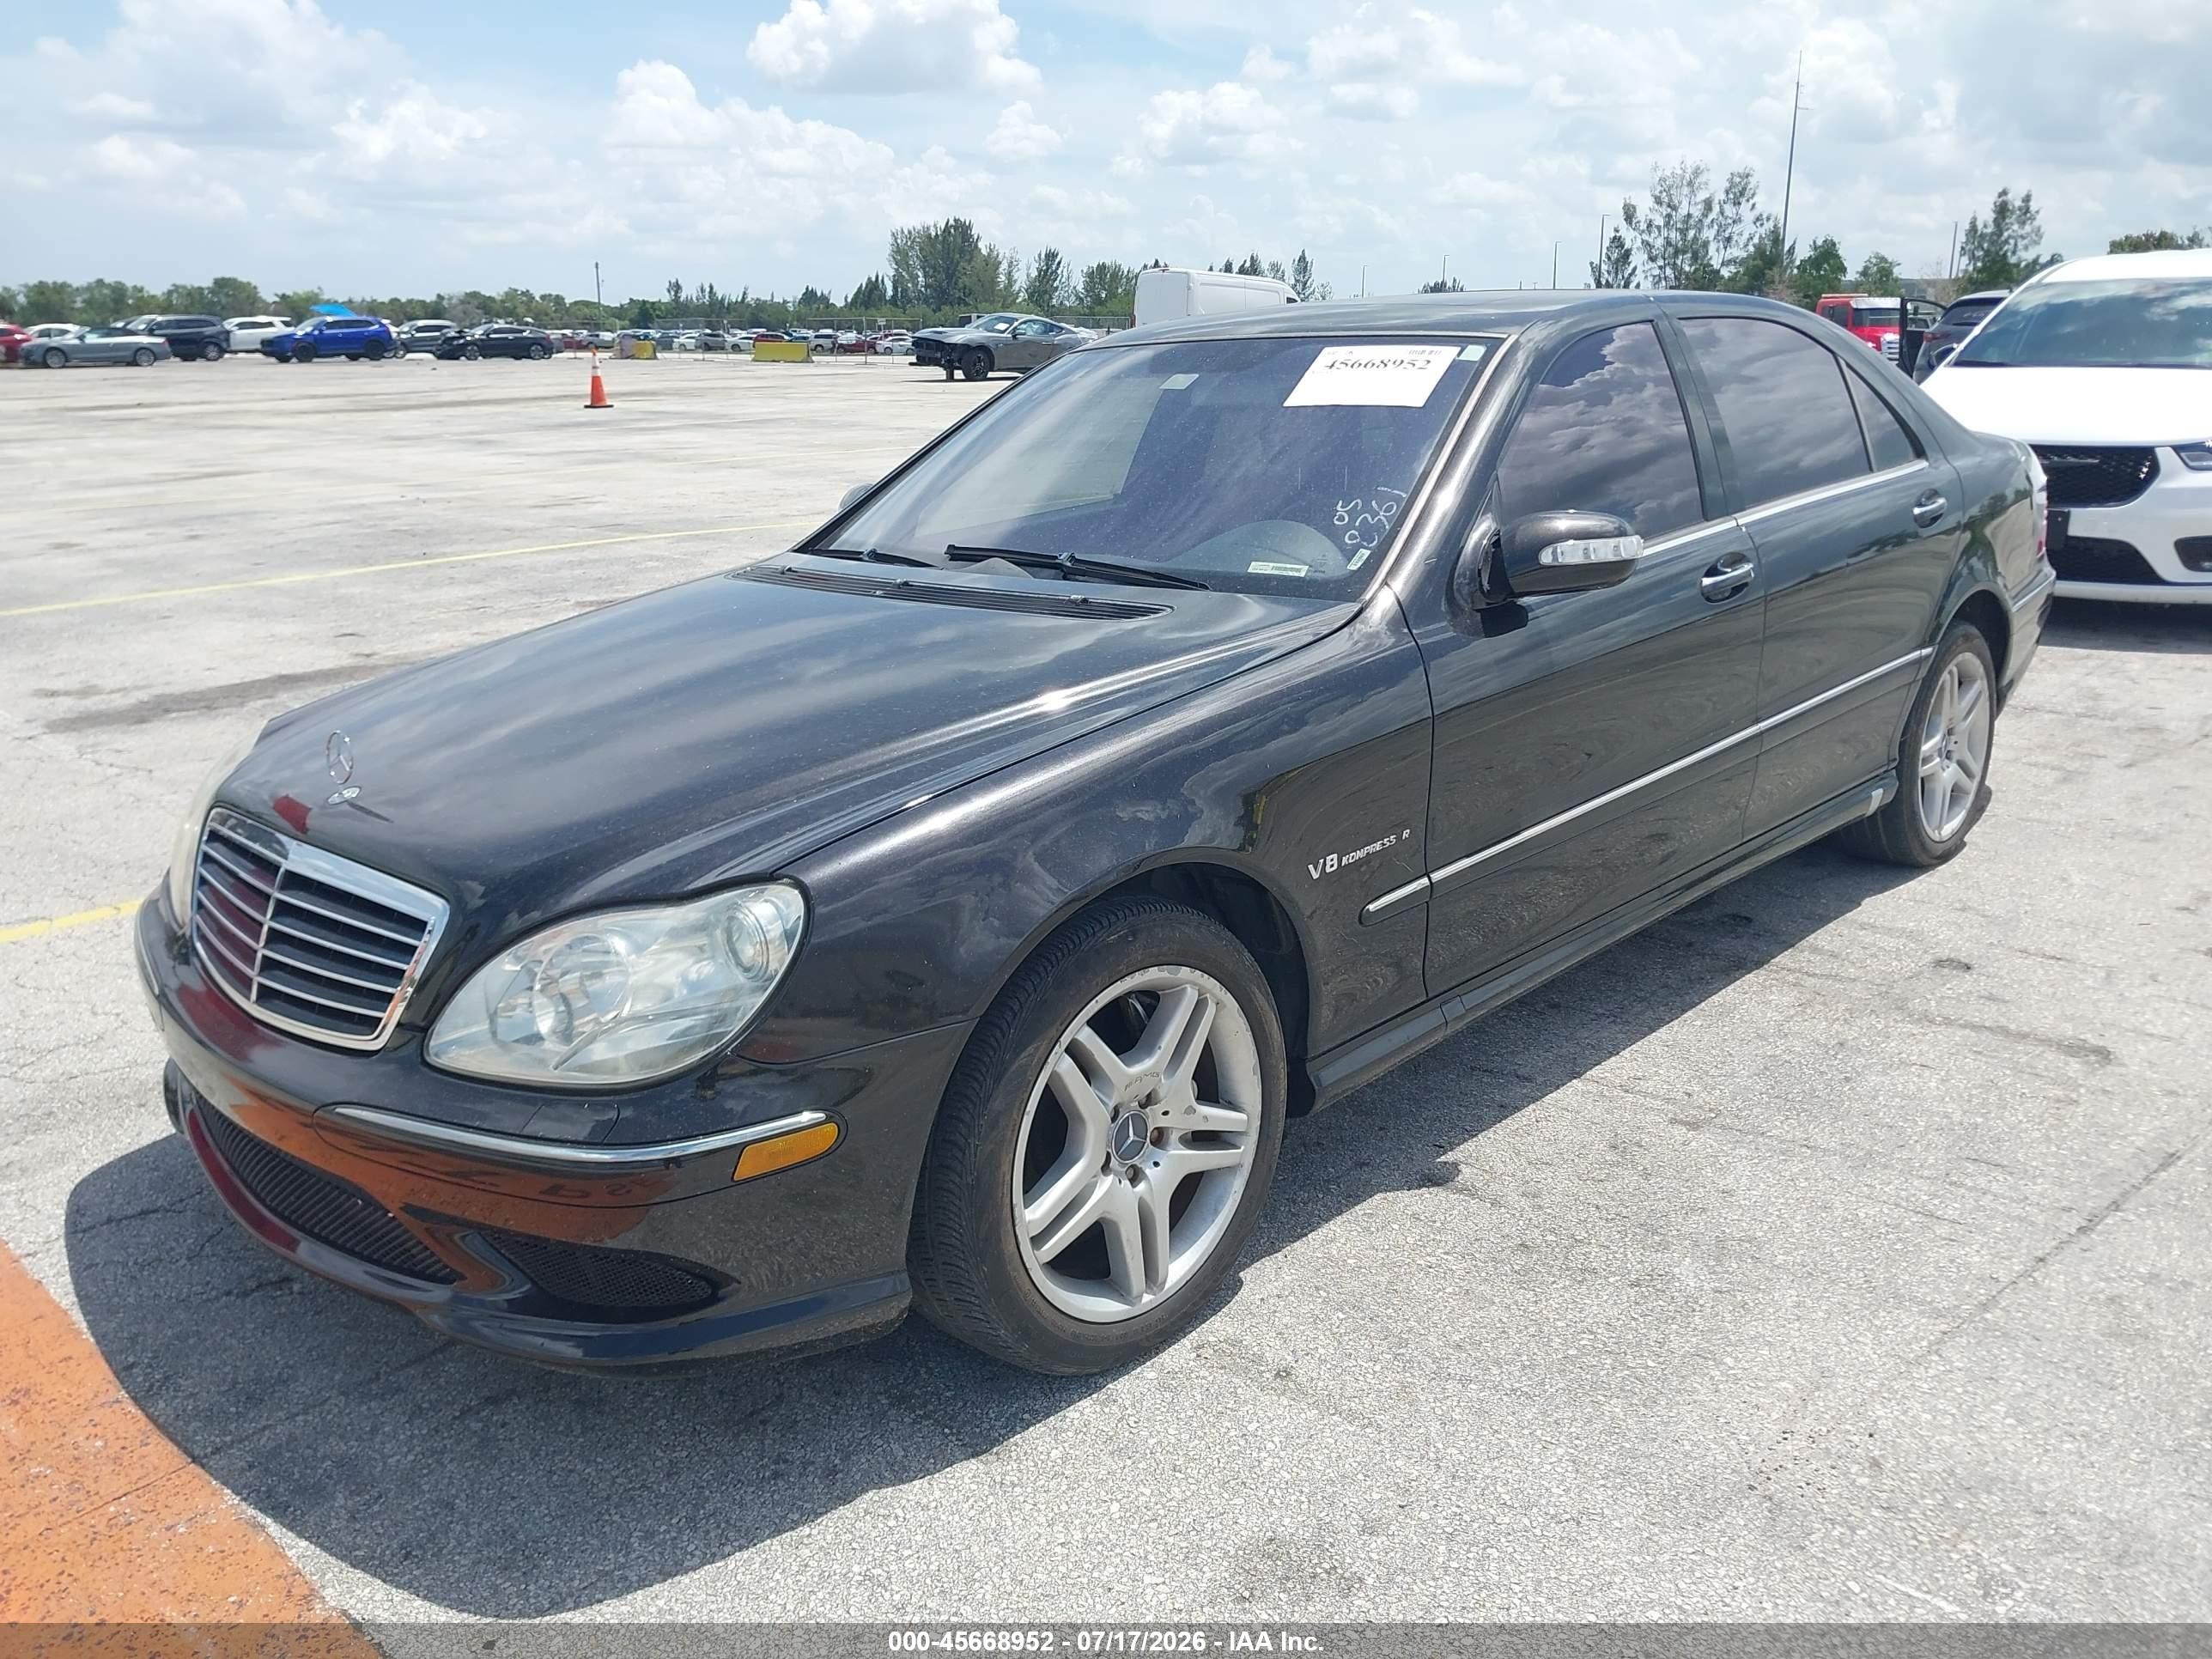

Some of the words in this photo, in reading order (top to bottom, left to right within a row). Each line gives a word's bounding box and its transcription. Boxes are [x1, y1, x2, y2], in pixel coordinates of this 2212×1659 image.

[1323, 358, 1432, 371] 45668952
[1307, 853, 1339, 880] V8
[1401, 828, 1411, 841] R
